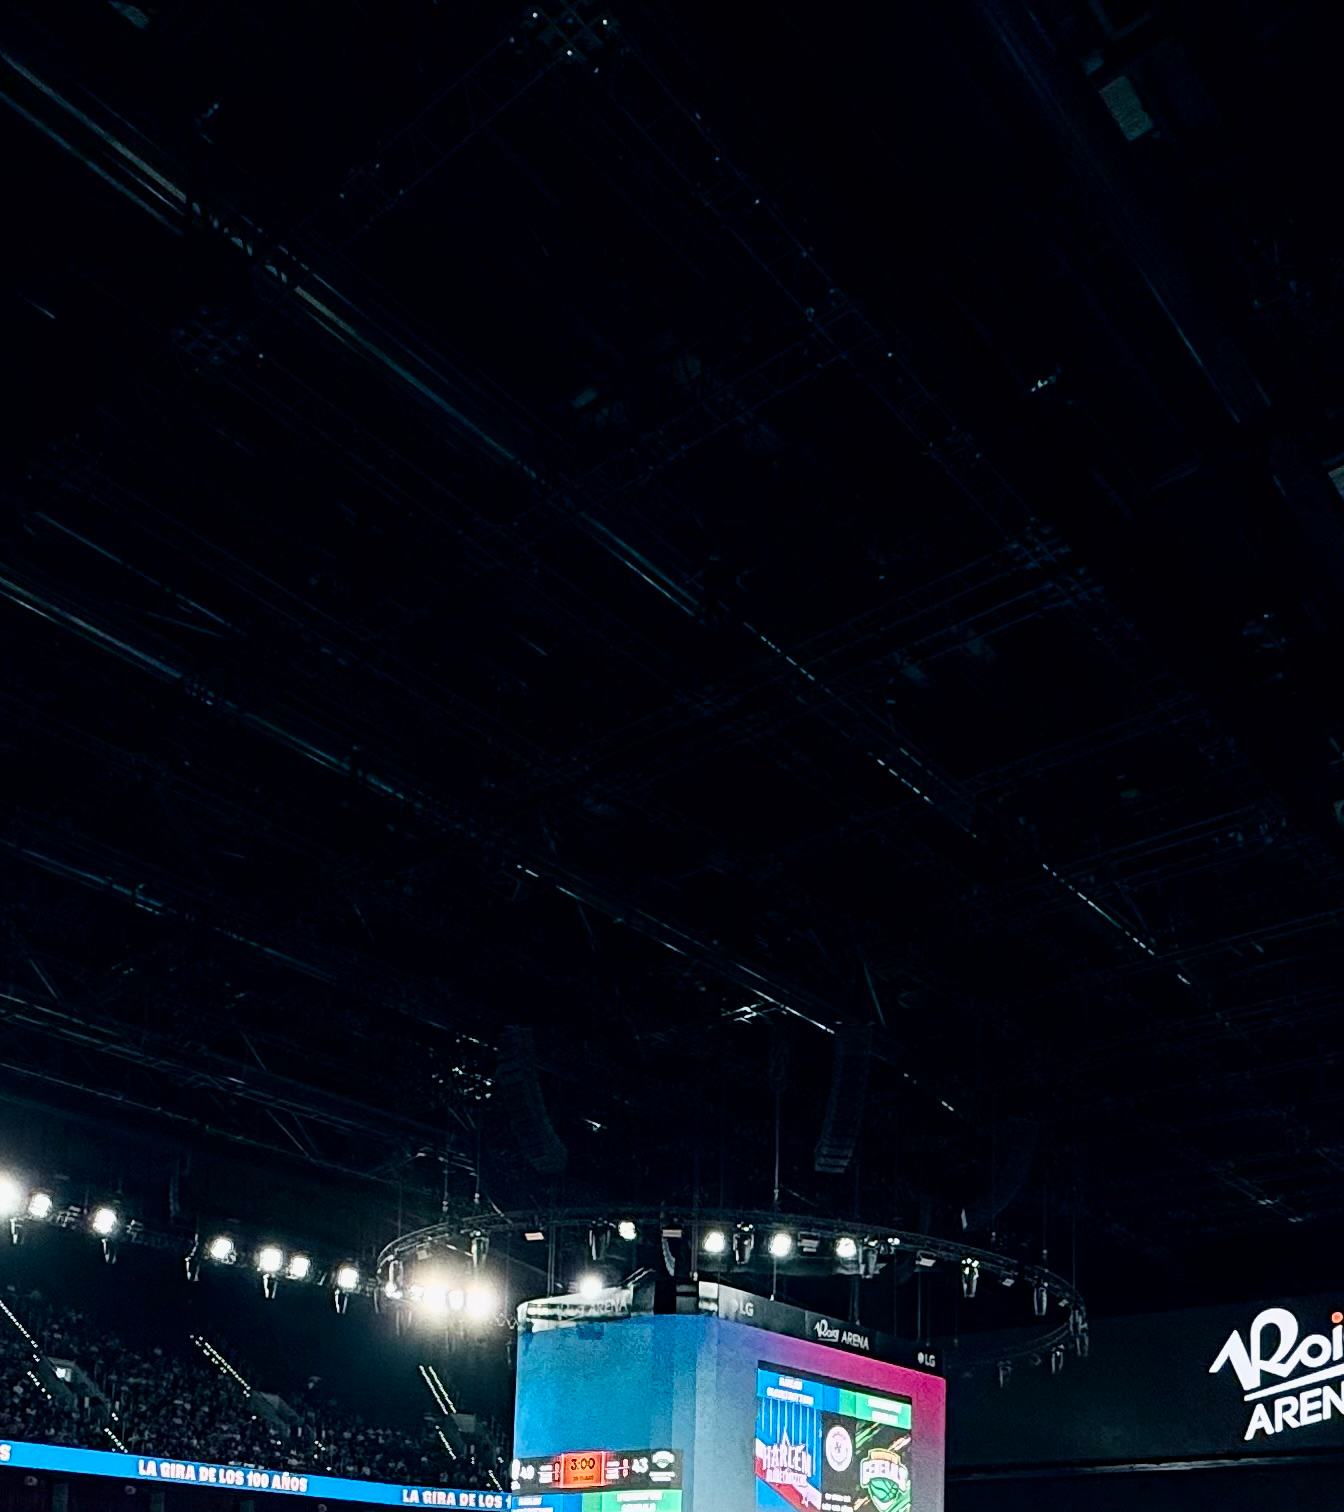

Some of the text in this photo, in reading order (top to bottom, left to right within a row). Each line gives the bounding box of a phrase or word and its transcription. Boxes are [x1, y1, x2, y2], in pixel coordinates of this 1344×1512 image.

[841, 1330, 870, 1351] ARENA
[924, 1353, 936, 1367] LG
[138, 1459, 308, 1493] LA GIRA DE LOS 100 AÑOS
[402, 1489, 419, 1504] LA
[422, 1490, 456, 1506] GIRA
[459, 1492, 476, 1507] DE
[478, 1494, 503, 1509] LOS
